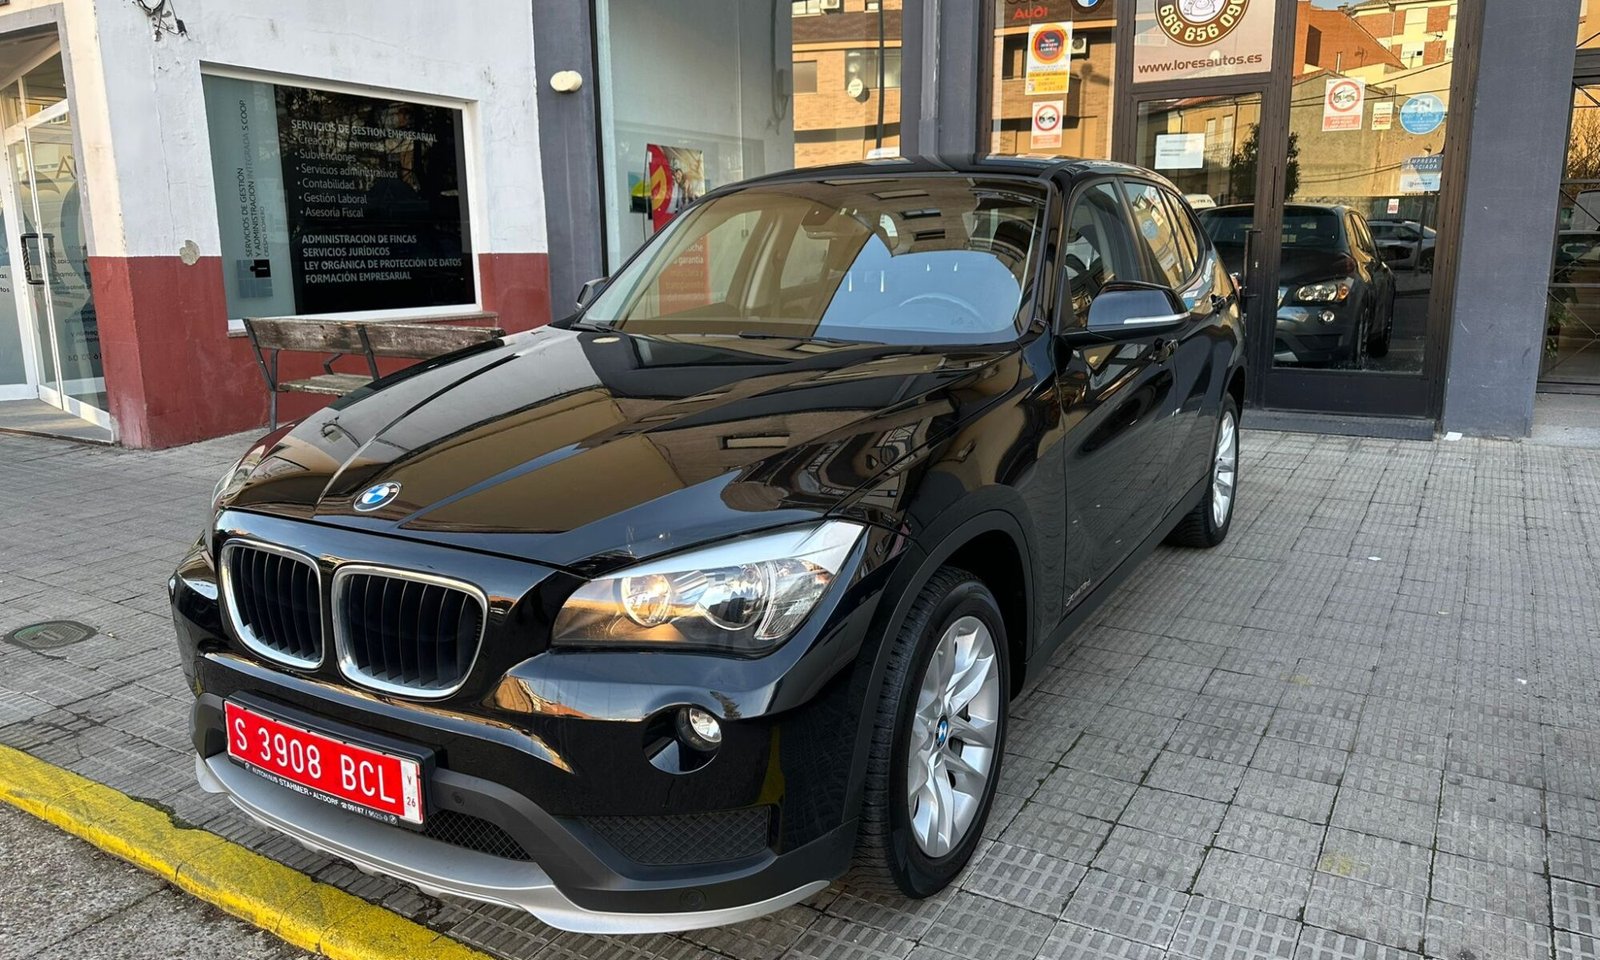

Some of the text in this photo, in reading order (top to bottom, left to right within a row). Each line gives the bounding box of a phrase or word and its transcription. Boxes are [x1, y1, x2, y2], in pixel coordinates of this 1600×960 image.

[1160, 4, 1184, 36] 666
[1184, 23, 1219, 42] 656
[1138, 54, 1263, 74] www.loresautos.es
[291, 120, 336, 133] SERVICIOS
[338, 124, 350, 134] DE
[387, 130, 438, 143] EMPRESARIAL
[300, 148, 357, 162] Subvenciones
[301, 163, 398, 179] Servicios administrativos
[302, 178, 355, 190] Contabilidad
[303, 191, 368, 205] Gestión Laboral
[241, 205, 248, 214] DE
[342, 207, 364, 218] Fiscal
[243, 215, 252, 258] SERVICIOS
[377, 235, 389, 243] DE
[390, 235, 417, 243] FINCAS
[302, 245, 391, 258] SERVICIOS JURÍDICOS
[304, 257, 462, 271] LEY ORGÁNICA DE PROTECCIÓN DE DATOS
[305, 271, 412, 284] FORMACIÓN EMPRESARIAL
[234, 717, 396, 804] S 3908 BCL
[252, 766, 279, 784] AUTOHAUS
[278, 778, 310, 796] STAHMER
[312, 791, 339, 806] ALTDORF
[407, 796, 416, 808] 26
